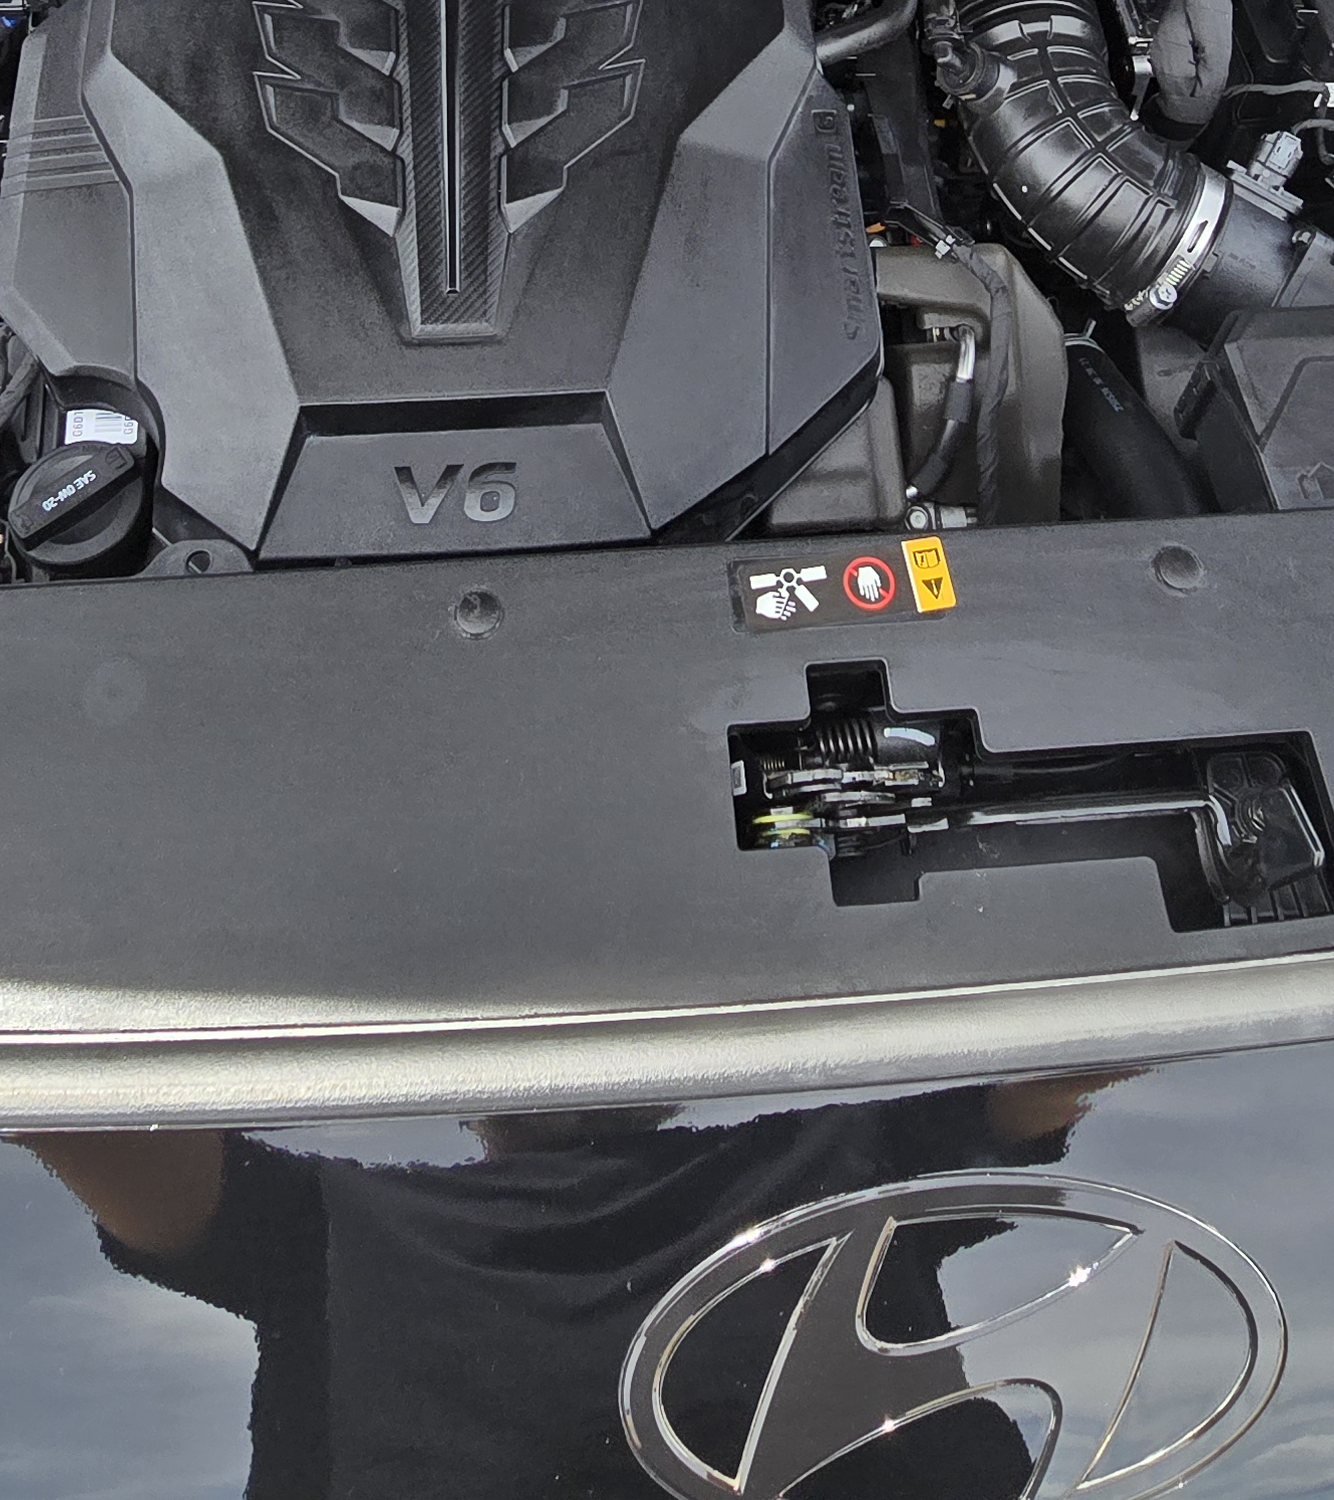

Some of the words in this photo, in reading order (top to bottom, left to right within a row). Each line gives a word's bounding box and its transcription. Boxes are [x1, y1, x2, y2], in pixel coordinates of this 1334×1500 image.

[73, 469, 97, 490] SAE
[393, 461, 517, 525] V6
[41, 484, 77, 512] 0W-20
